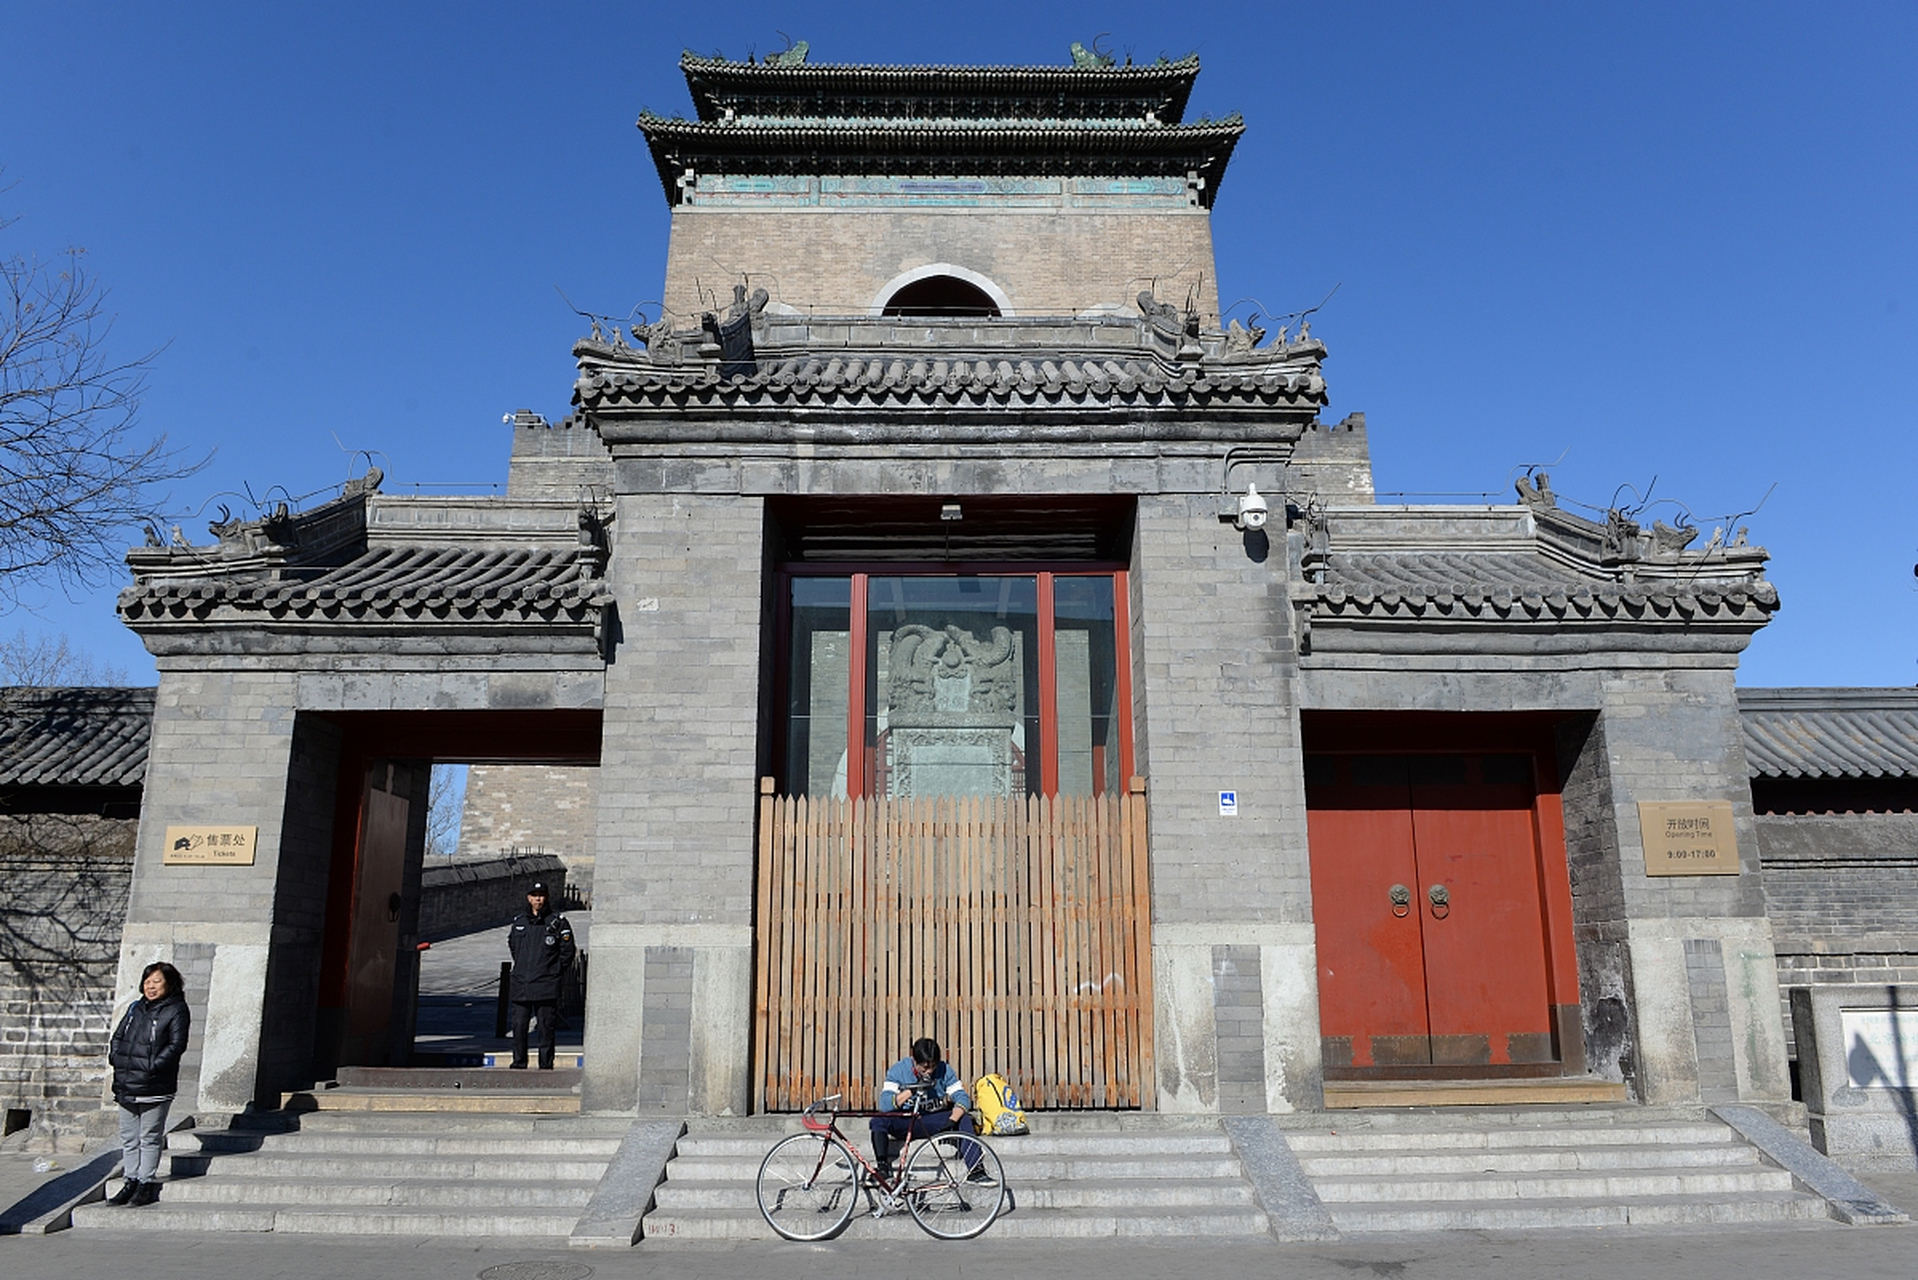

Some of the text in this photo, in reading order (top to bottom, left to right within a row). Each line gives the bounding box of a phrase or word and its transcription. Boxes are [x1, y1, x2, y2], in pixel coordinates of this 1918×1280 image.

[1666, 818, 1710, 830] 开放时间
[207, 833, 245, 847] 售票处
